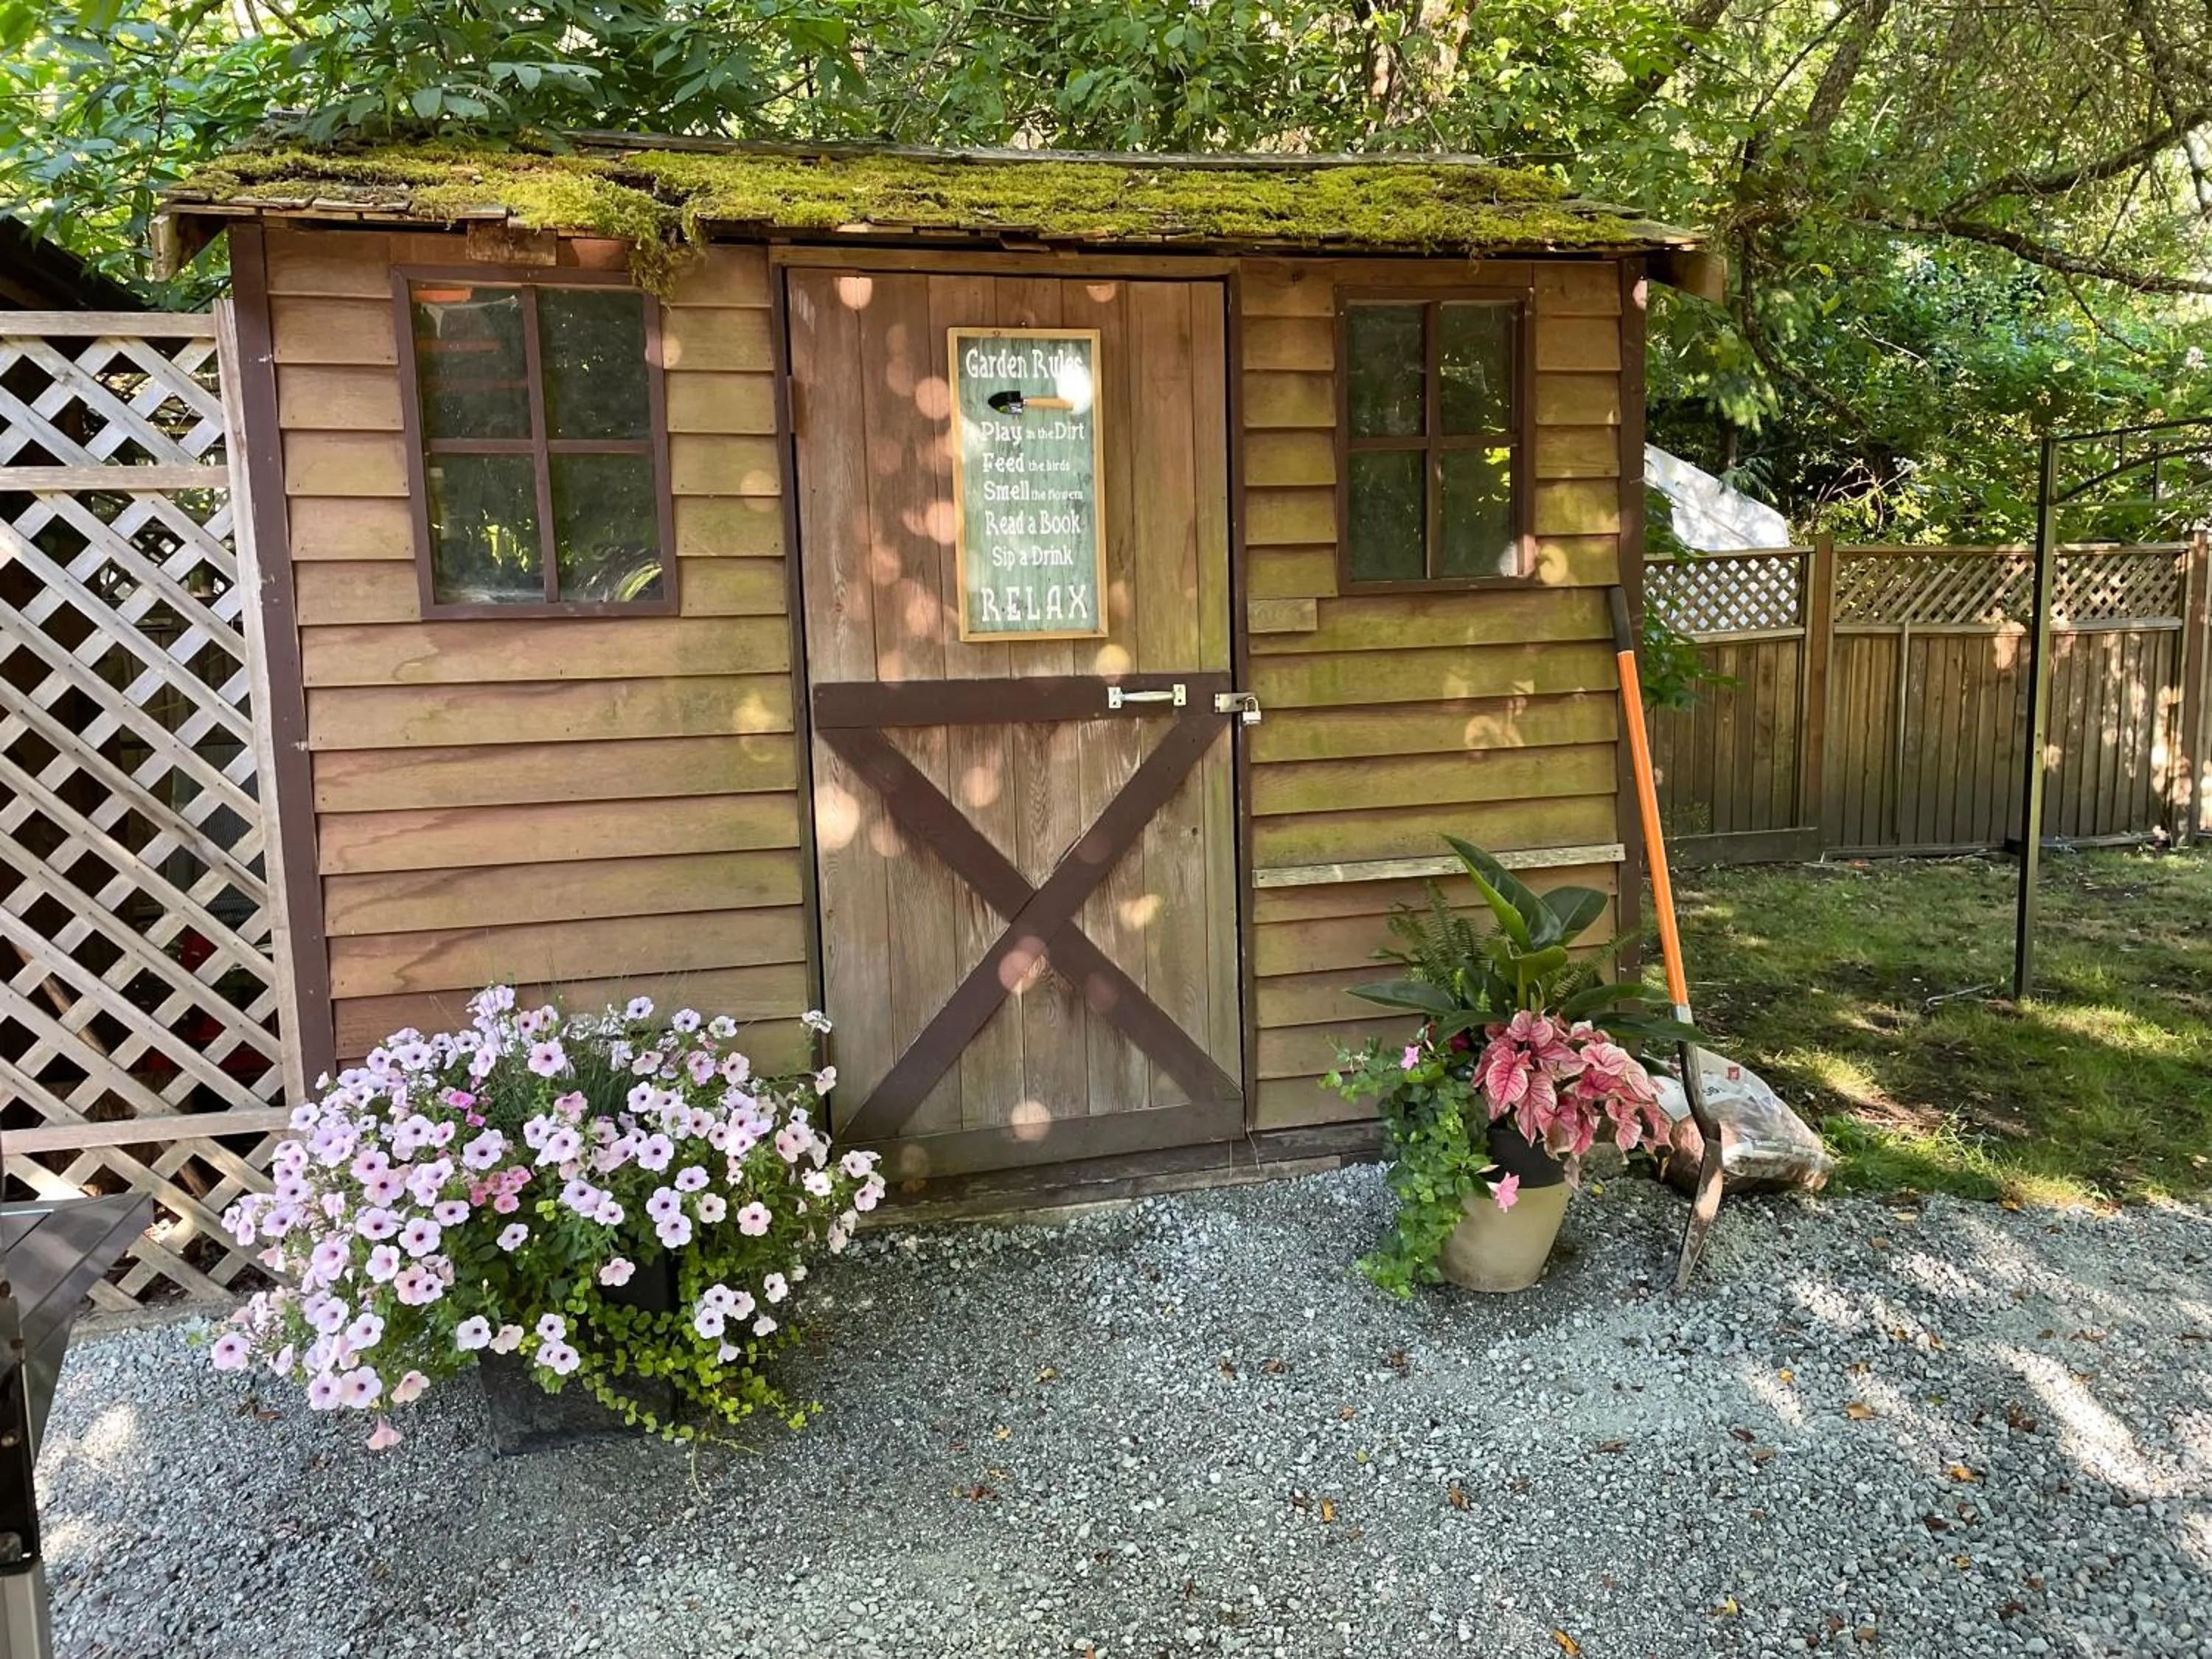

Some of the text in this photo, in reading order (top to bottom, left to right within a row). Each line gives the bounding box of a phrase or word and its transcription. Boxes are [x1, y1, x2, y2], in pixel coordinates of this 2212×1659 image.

[965, 347, 1084, 378] Garden Rules
[981, 421, 1022, 446] Play
[1037, 426, 1054, 440] the
[1054, 421, 1085, 440] Dirt
[982, 452, 1071, 473] Feed the birds
[984, 480, 1029, 501] Smell
[985, 509, 1081, 536] Read a Book
[992, 544, 1074, 571] Sip a Drink
[981, 584, 1088, 622] RELAX
